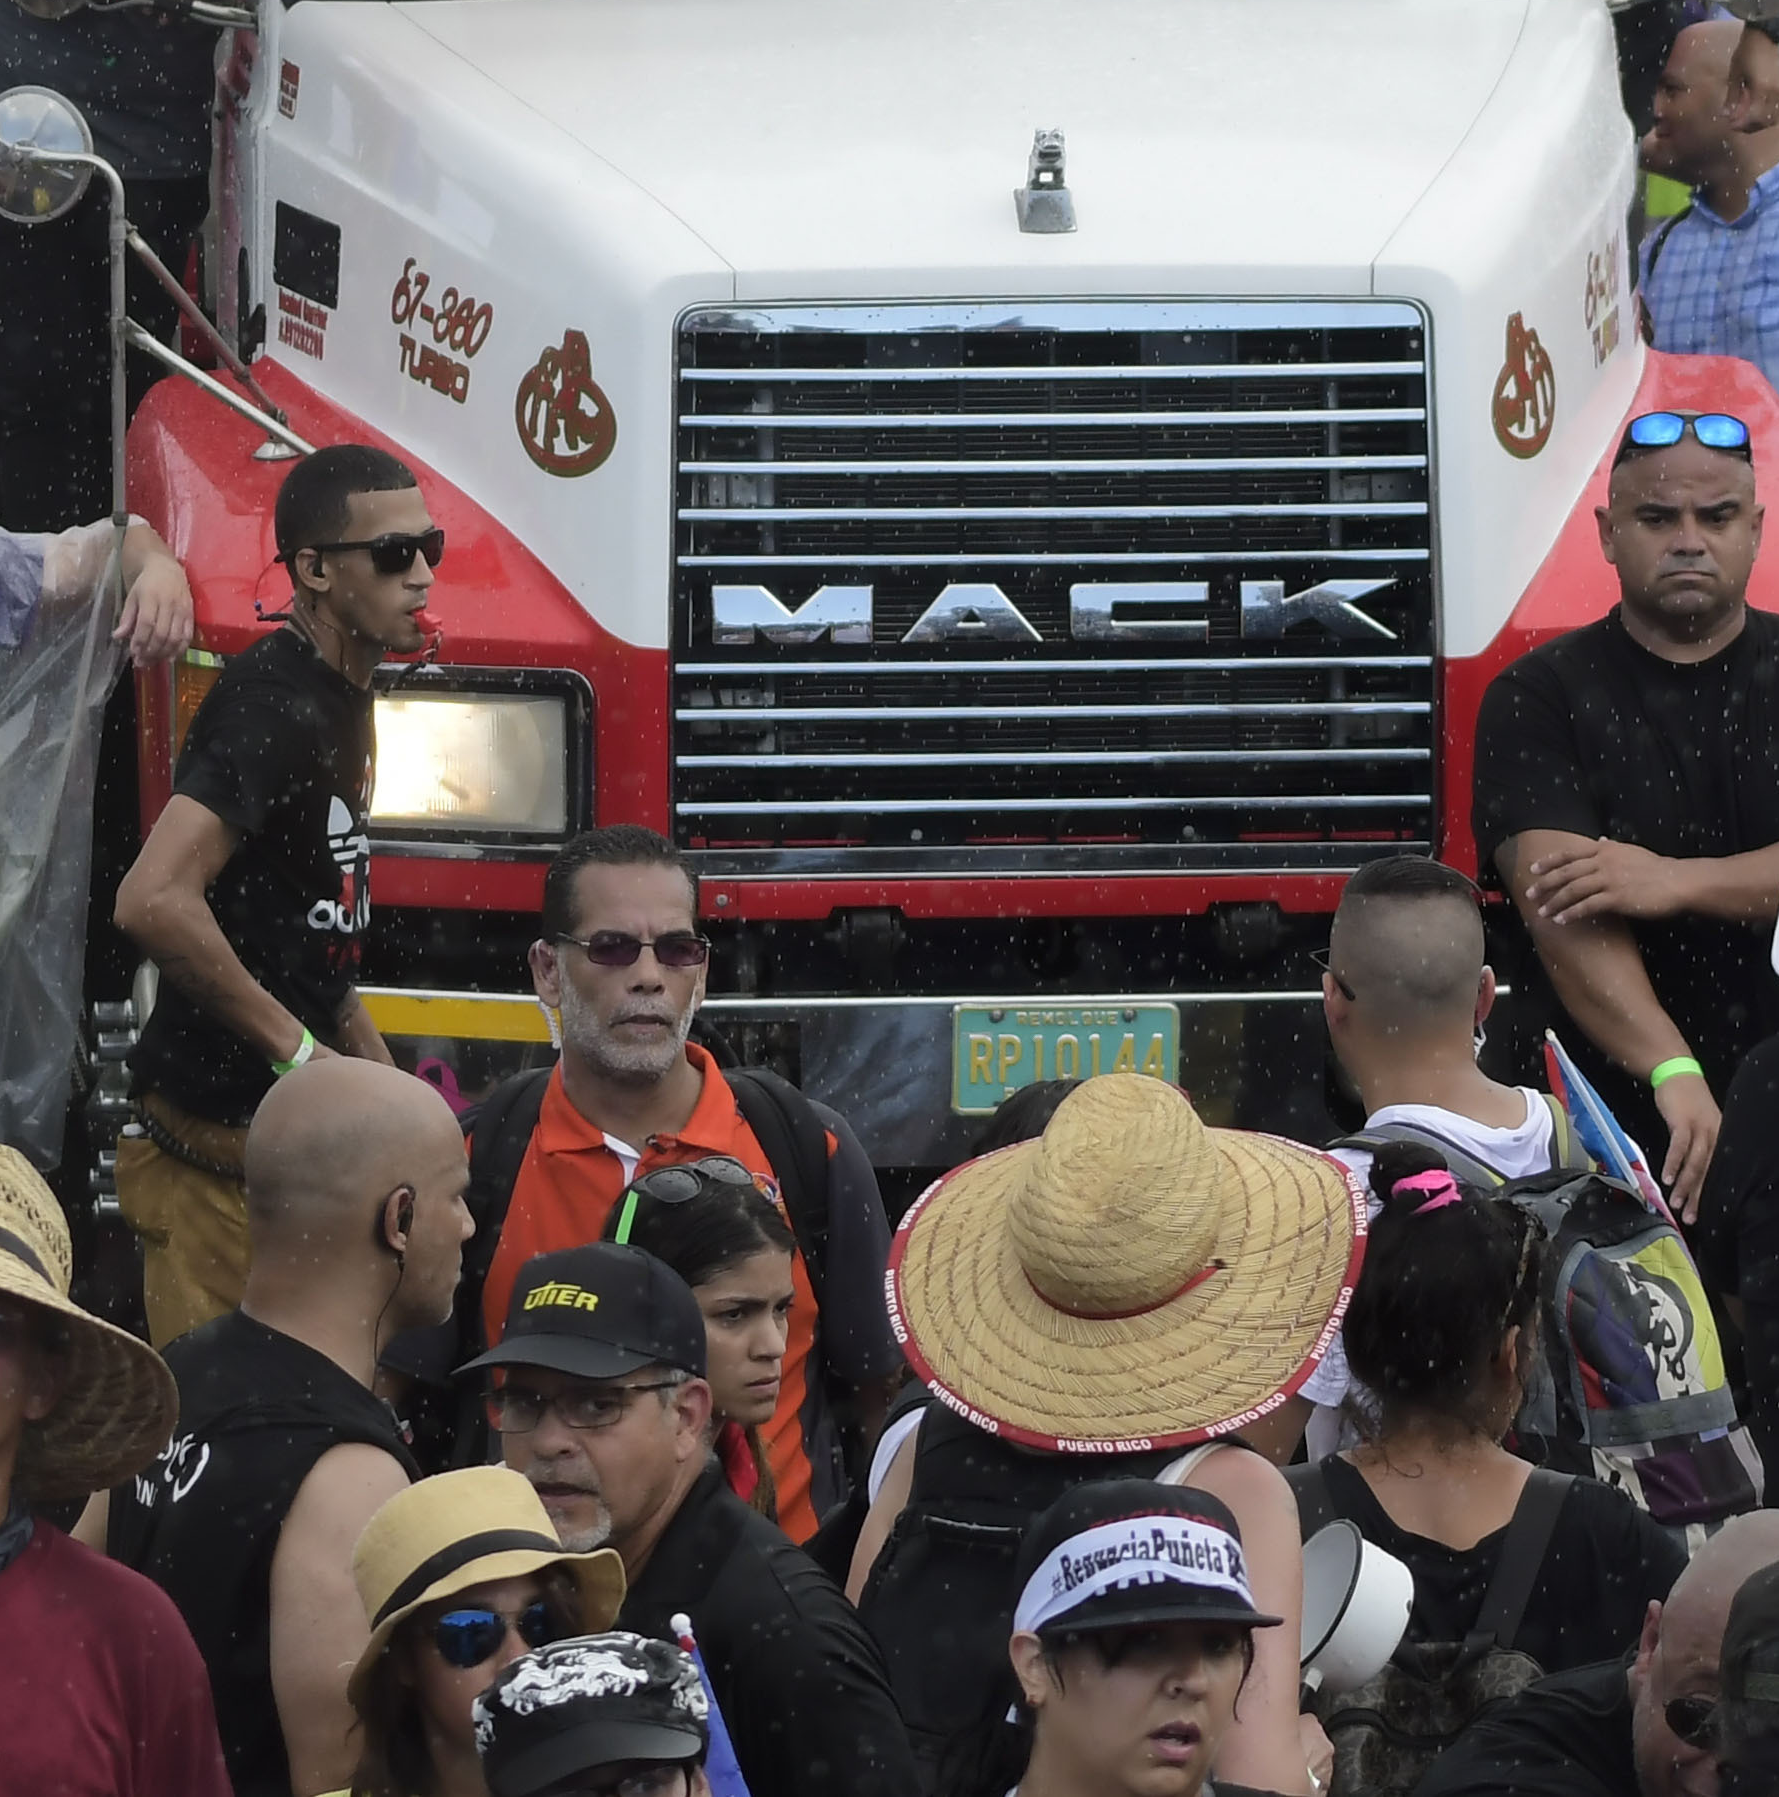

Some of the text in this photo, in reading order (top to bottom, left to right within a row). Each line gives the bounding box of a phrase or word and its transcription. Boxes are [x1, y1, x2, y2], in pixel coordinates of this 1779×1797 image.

[398, 332, 471, 405] TURBO
[711, 578, 1400, 644] MACK
[1015, 1010, 1120, 1026] REMOLQUE
[968, 1033, 1165, 1084] RP10144
[1353, 1191, 1368, 1237] PUERTO
[885, 1268, 908, 1345] PUERTO RICO
[1309, 1285, 1355, 1361] PUERTO RICO
[926, 1378, 999, 1435] PUERTO RICO
[1205, 1391, 1288, 1439] PUERTO RICO
[1056, 1438, 1153, 1453] PUERTO RICO
